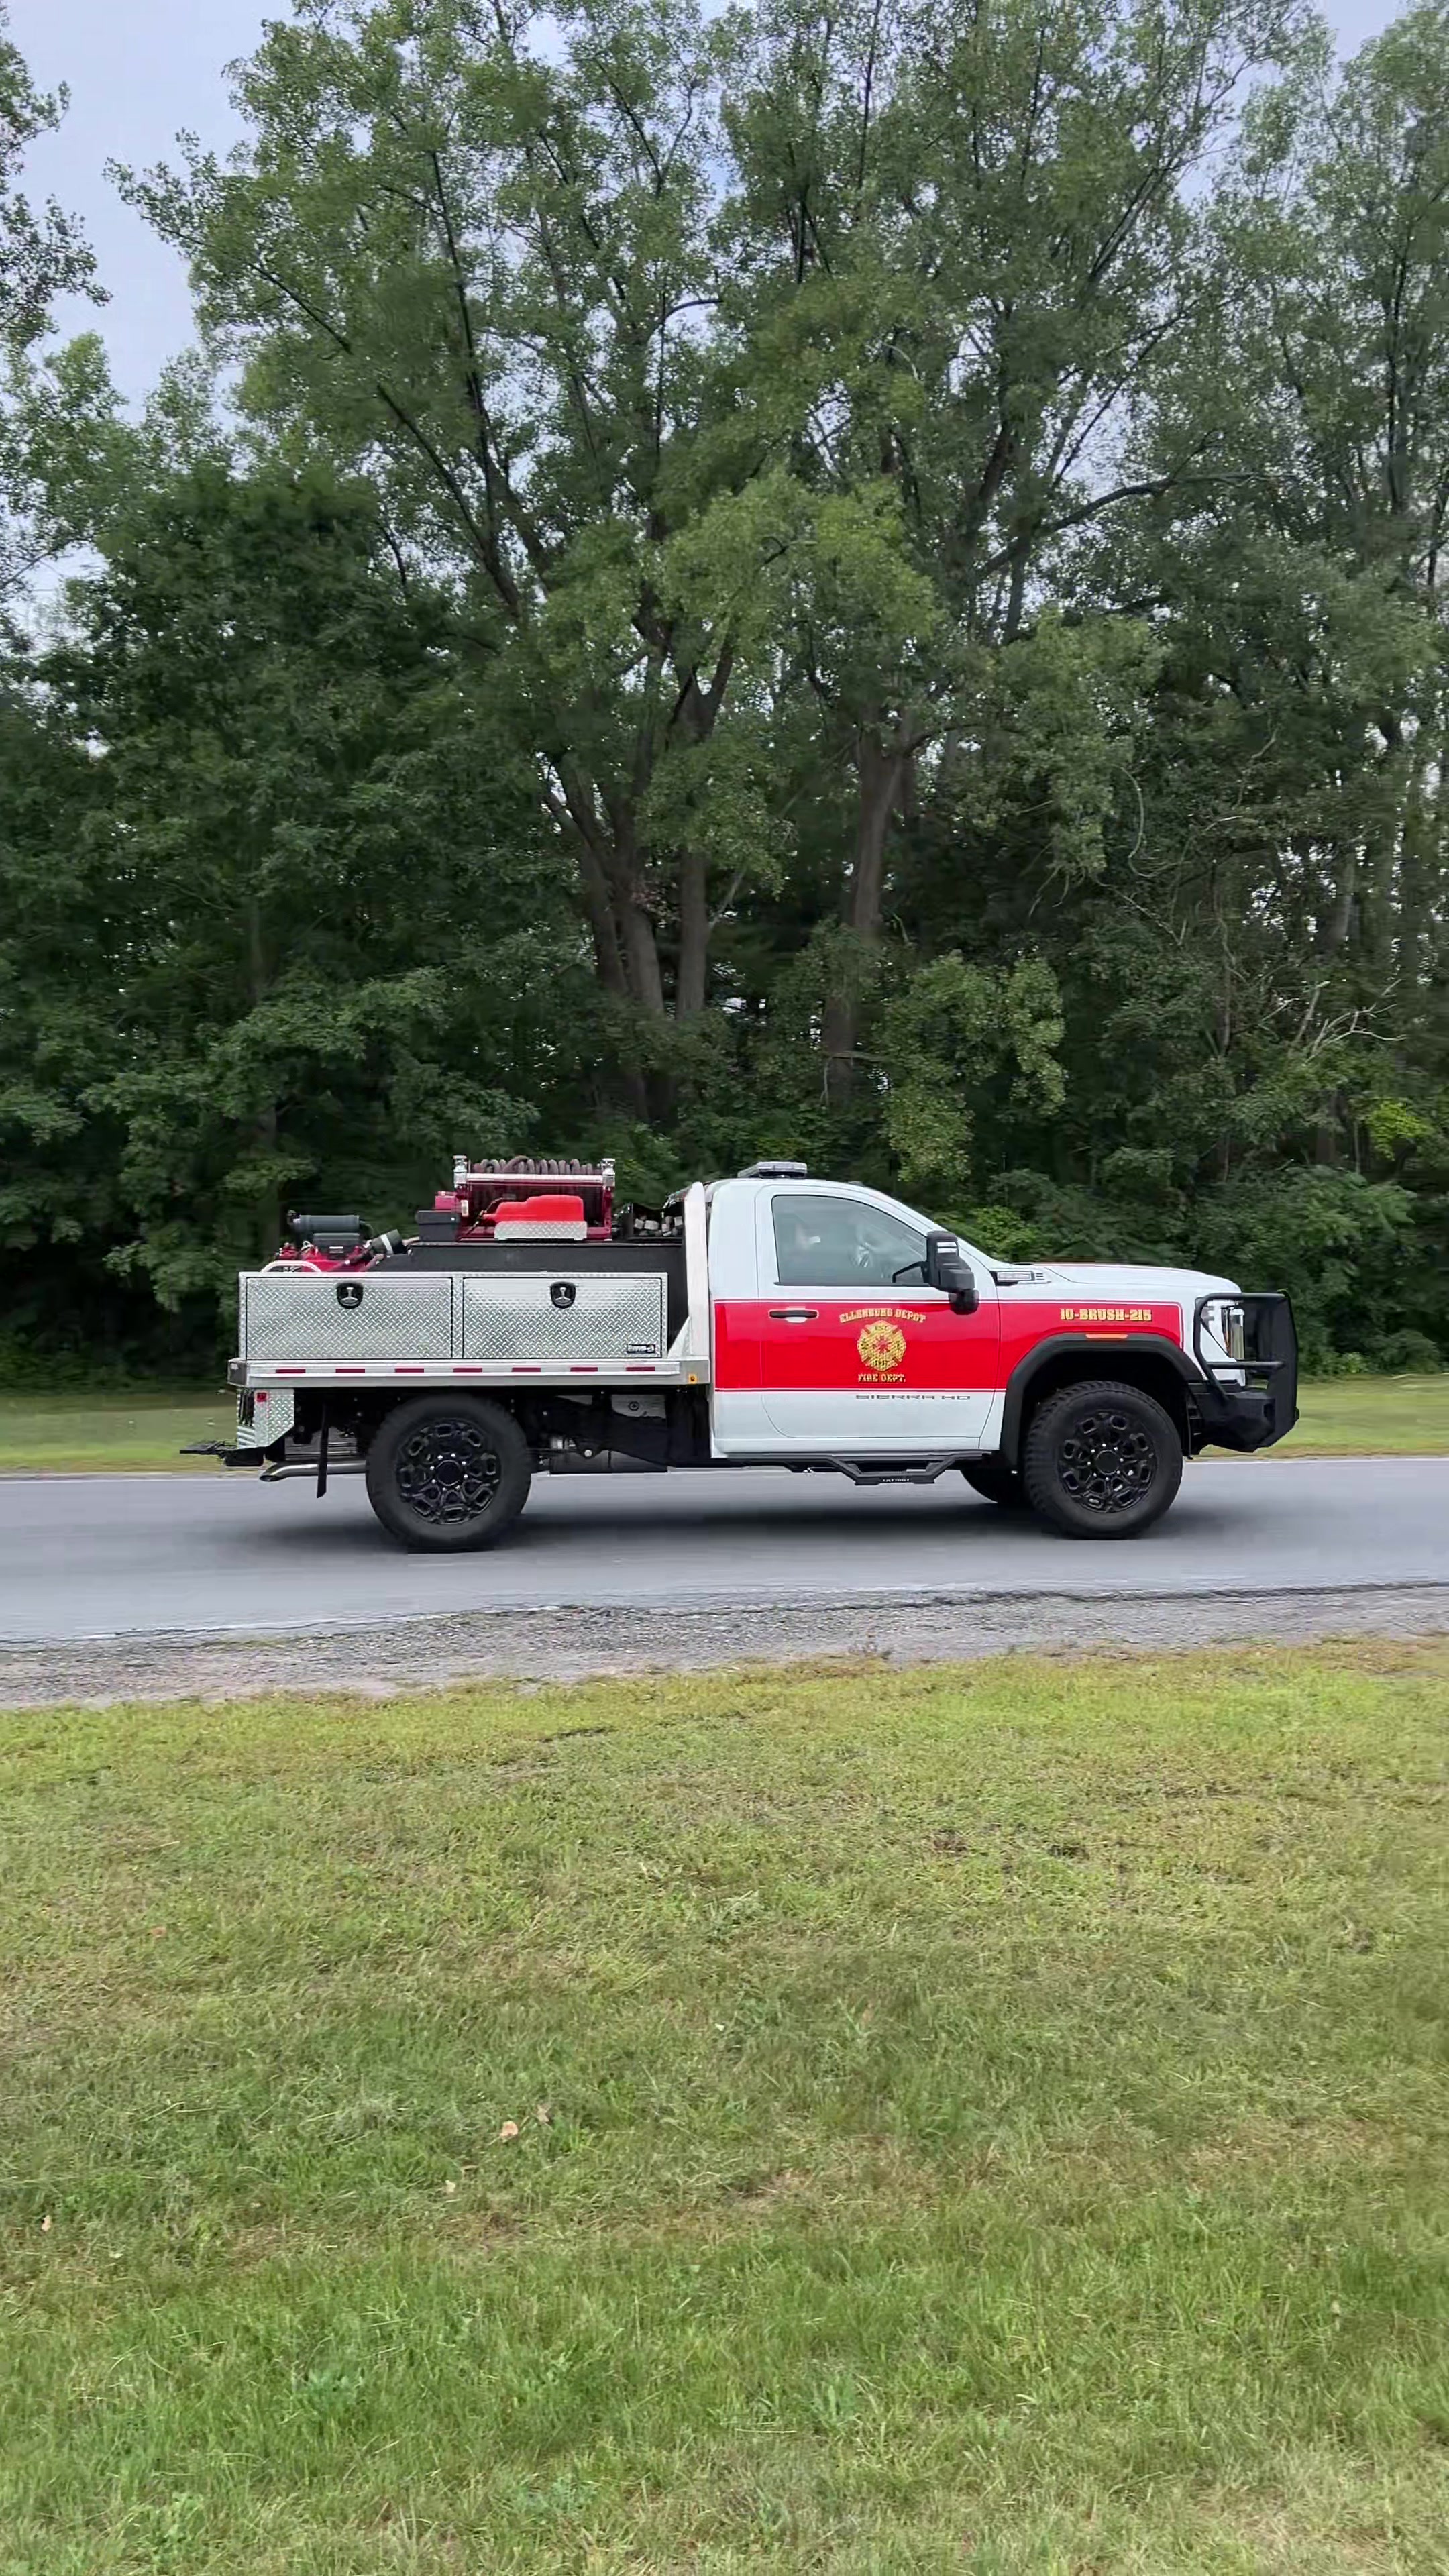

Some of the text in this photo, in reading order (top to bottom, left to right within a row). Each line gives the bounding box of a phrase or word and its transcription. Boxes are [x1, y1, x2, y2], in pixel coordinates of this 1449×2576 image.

[839, 1307, 926, 1323] ELLENBURG DEPOT
[1060, 1308, 1152, 1322] 10-BRUSH-215
[858, 1373, 906, 1383] FIRE DEPT.
